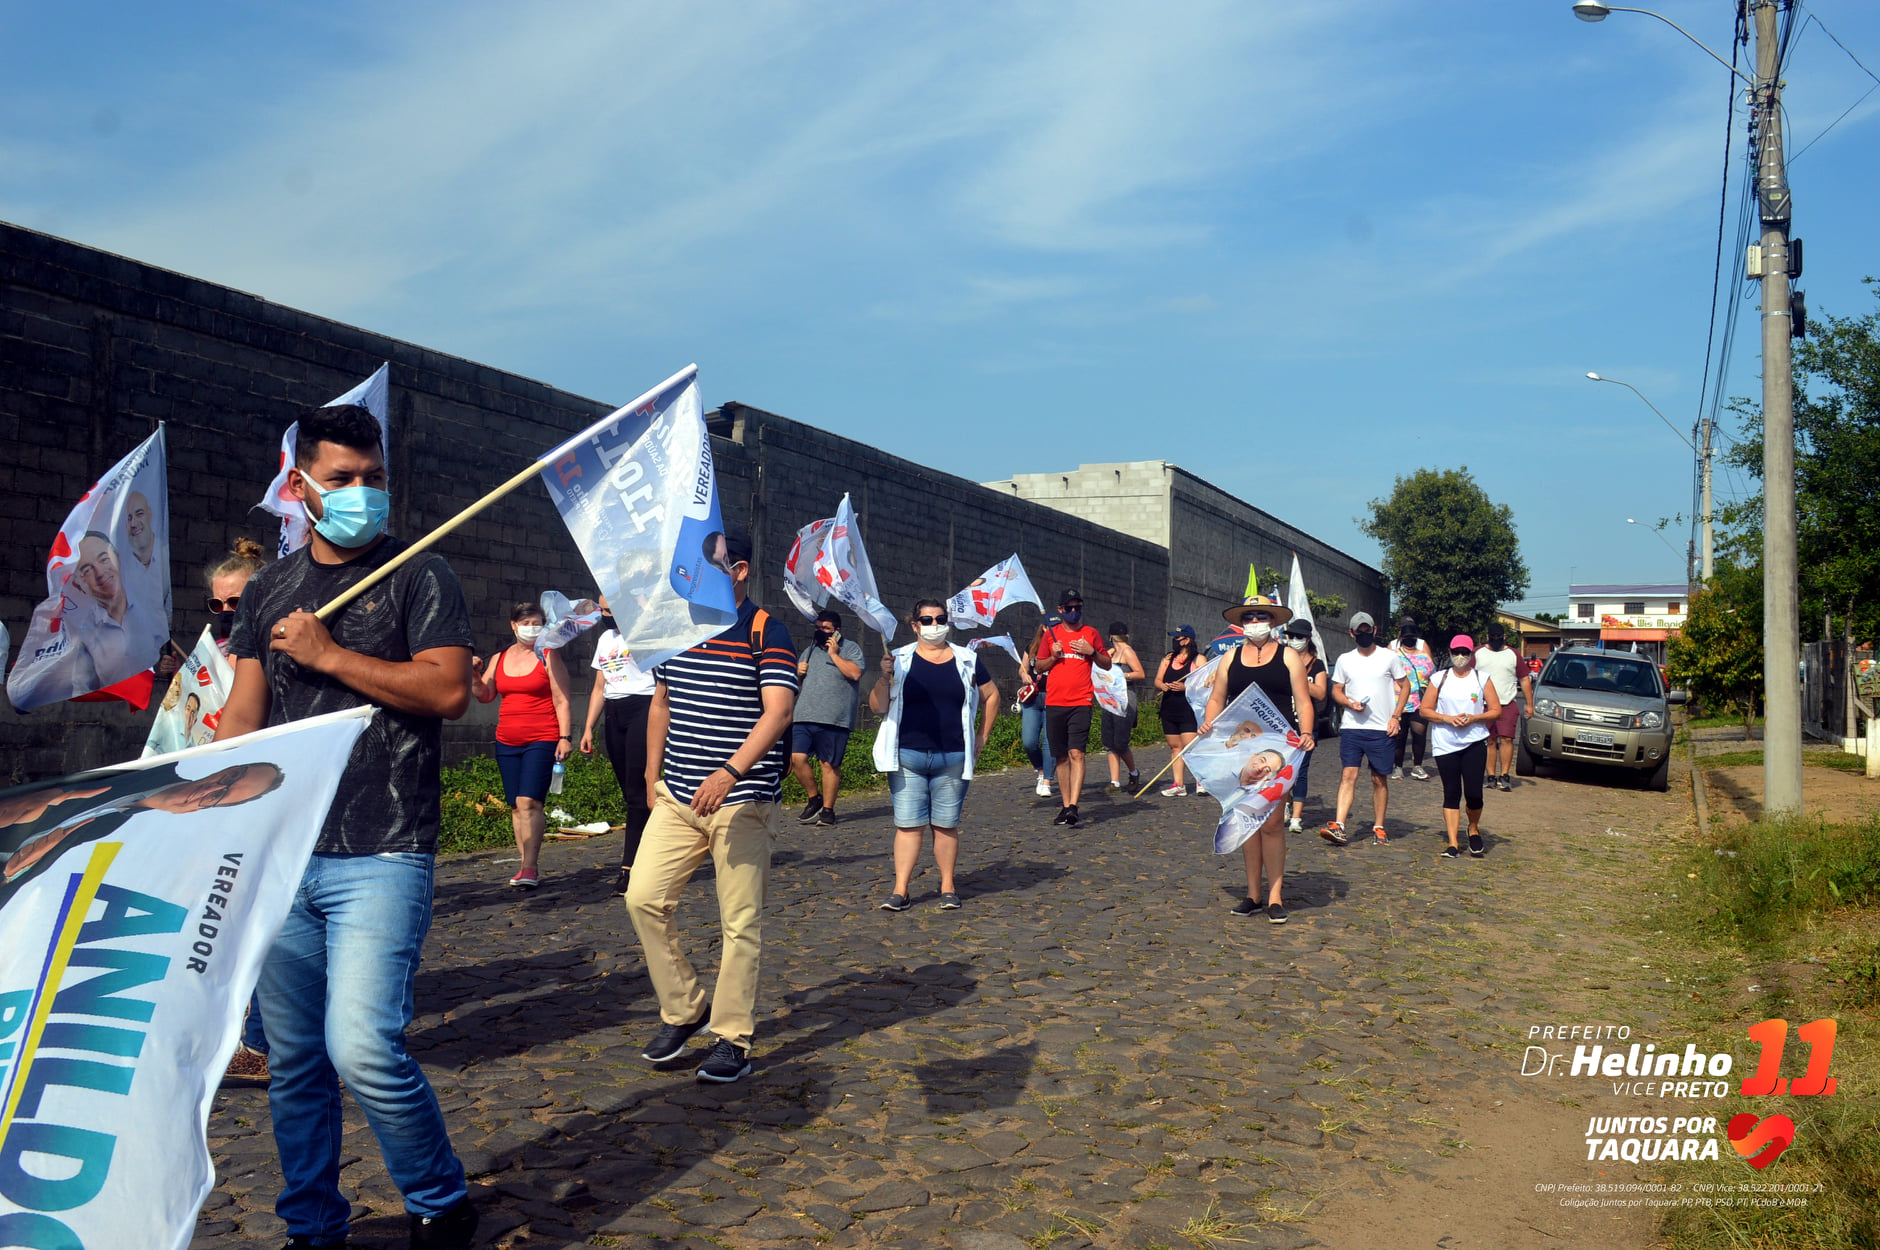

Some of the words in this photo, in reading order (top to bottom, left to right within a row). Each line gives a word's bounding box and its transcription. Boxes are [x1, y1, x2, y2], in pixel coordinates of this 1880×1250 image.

[1250, 701, 1284, 734] TAQUARA
[1254, 697, 1277, 718] JUNTOS
[1274, 716, 1288, 729] POR
[186, 853, 244, 974] VEREADOR
